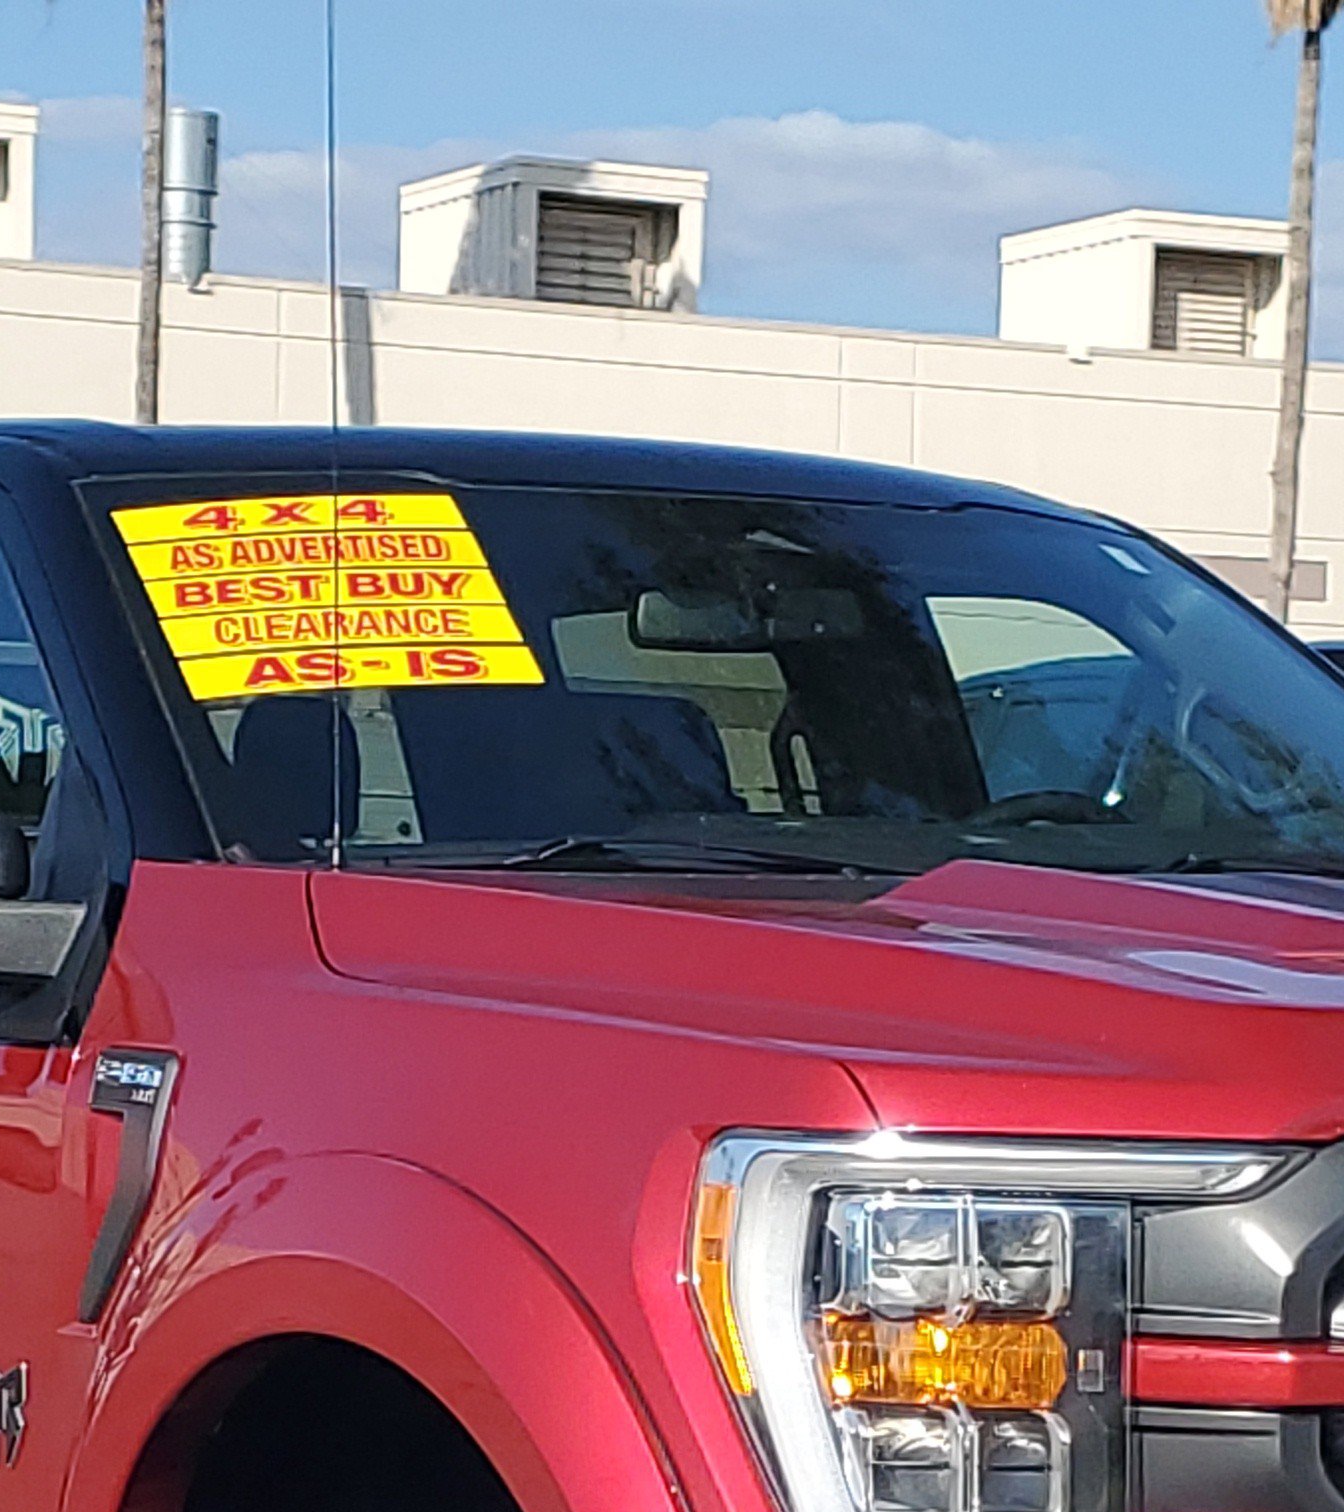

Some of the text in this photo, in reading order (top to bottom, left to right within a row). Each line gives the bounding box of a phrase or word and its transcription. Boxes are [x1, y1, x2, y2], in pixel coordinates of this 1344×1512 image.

[170, 534, 451, 571] AS ADVERTISED
[174, 571, 473, 609] BEST BUY
[214, 608, 473, 645] CLEARANCE
